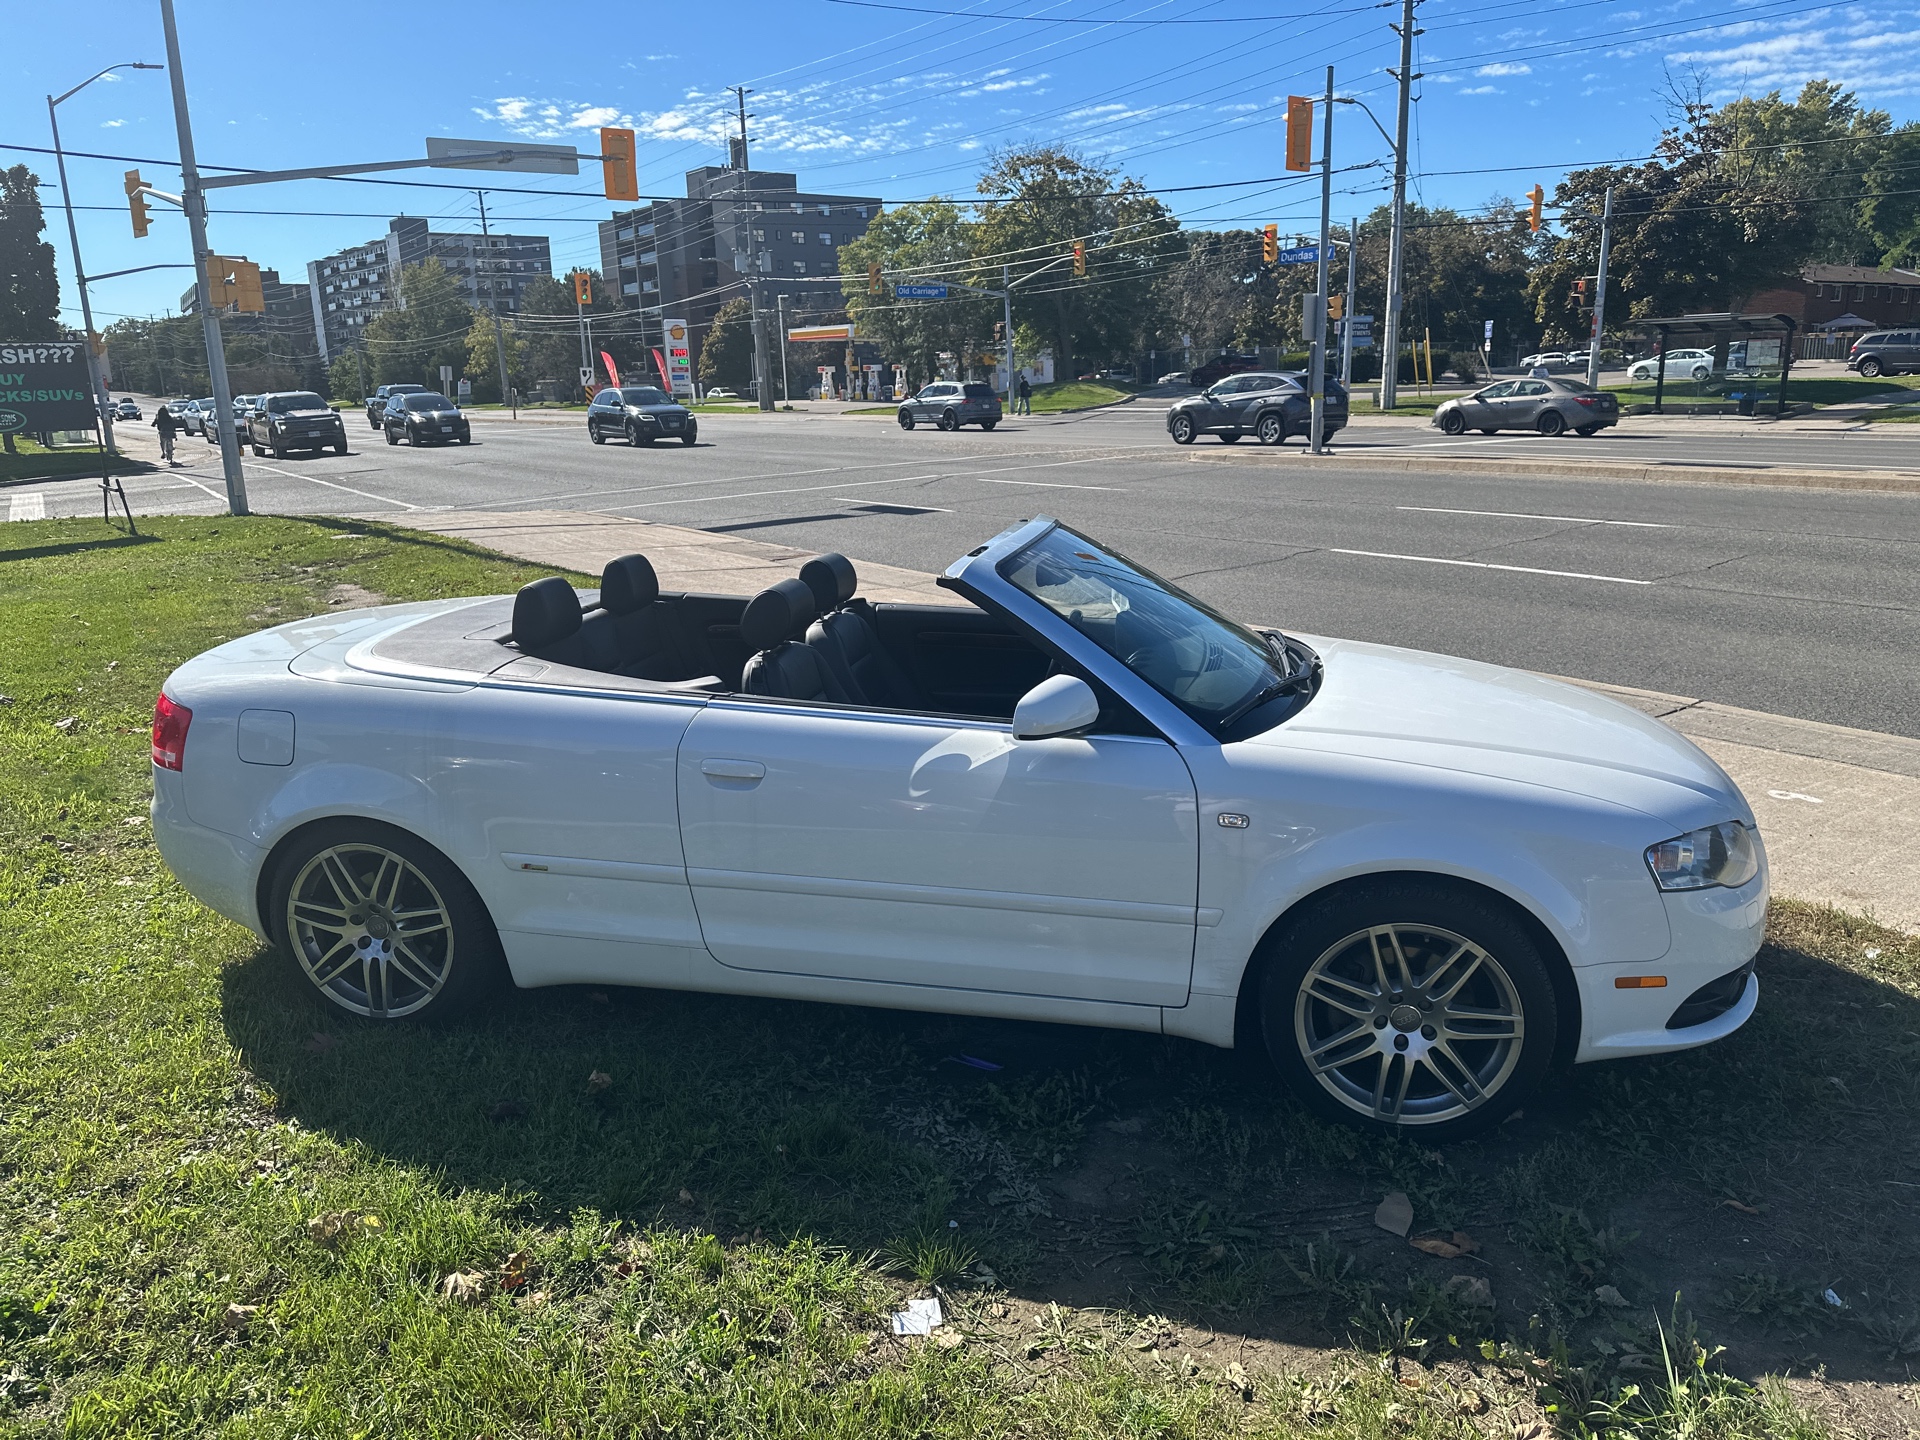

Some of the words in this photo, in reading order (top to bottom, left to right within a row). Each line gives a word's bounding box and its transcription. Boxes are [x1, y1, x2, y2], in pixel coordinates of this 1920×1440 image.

[1281, 251, 1313, 261] Dundas
[912, 288, 939, 296] Carriage
[0, 347, 75, 364] SH???
